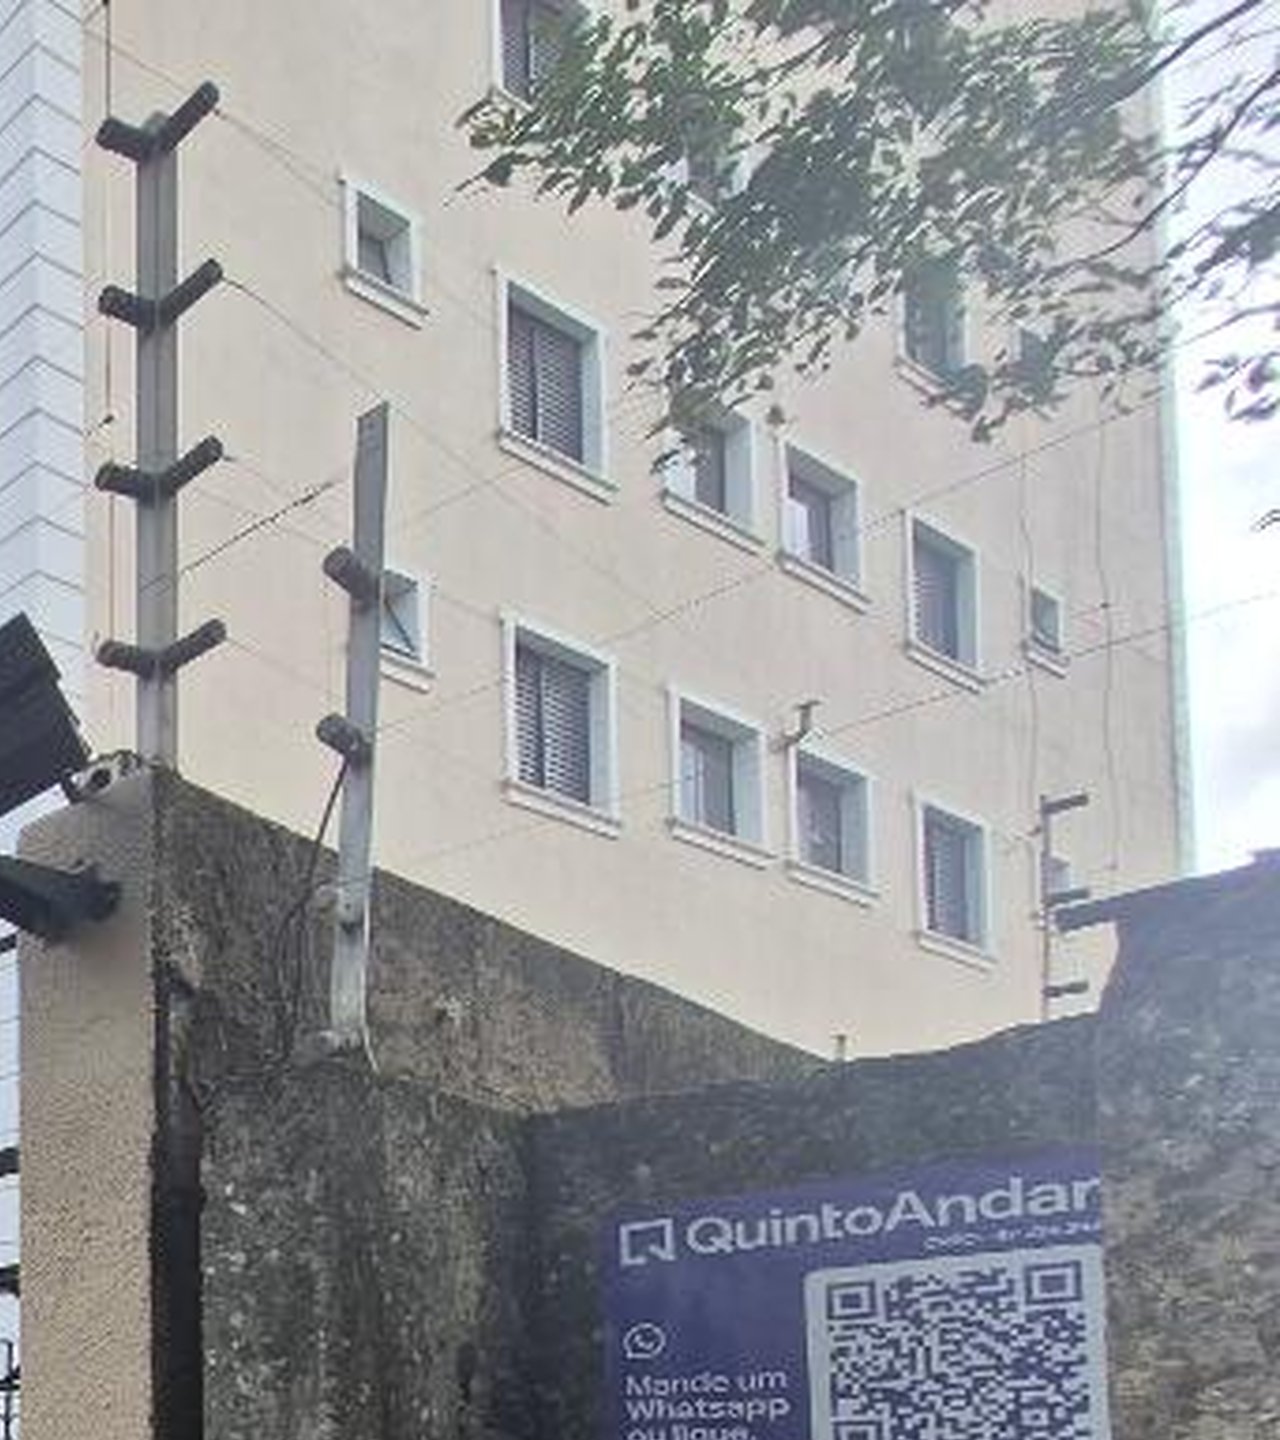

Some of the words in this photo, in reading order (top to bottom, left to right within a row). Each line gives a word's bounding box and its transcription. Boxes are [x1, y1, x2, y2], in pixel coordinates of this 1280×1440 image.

[686, 1177, 1101, 1256] QuintoAndar
[626, 1372, 730, 1396] Mande
[737, 1371, 788, 1393] um
